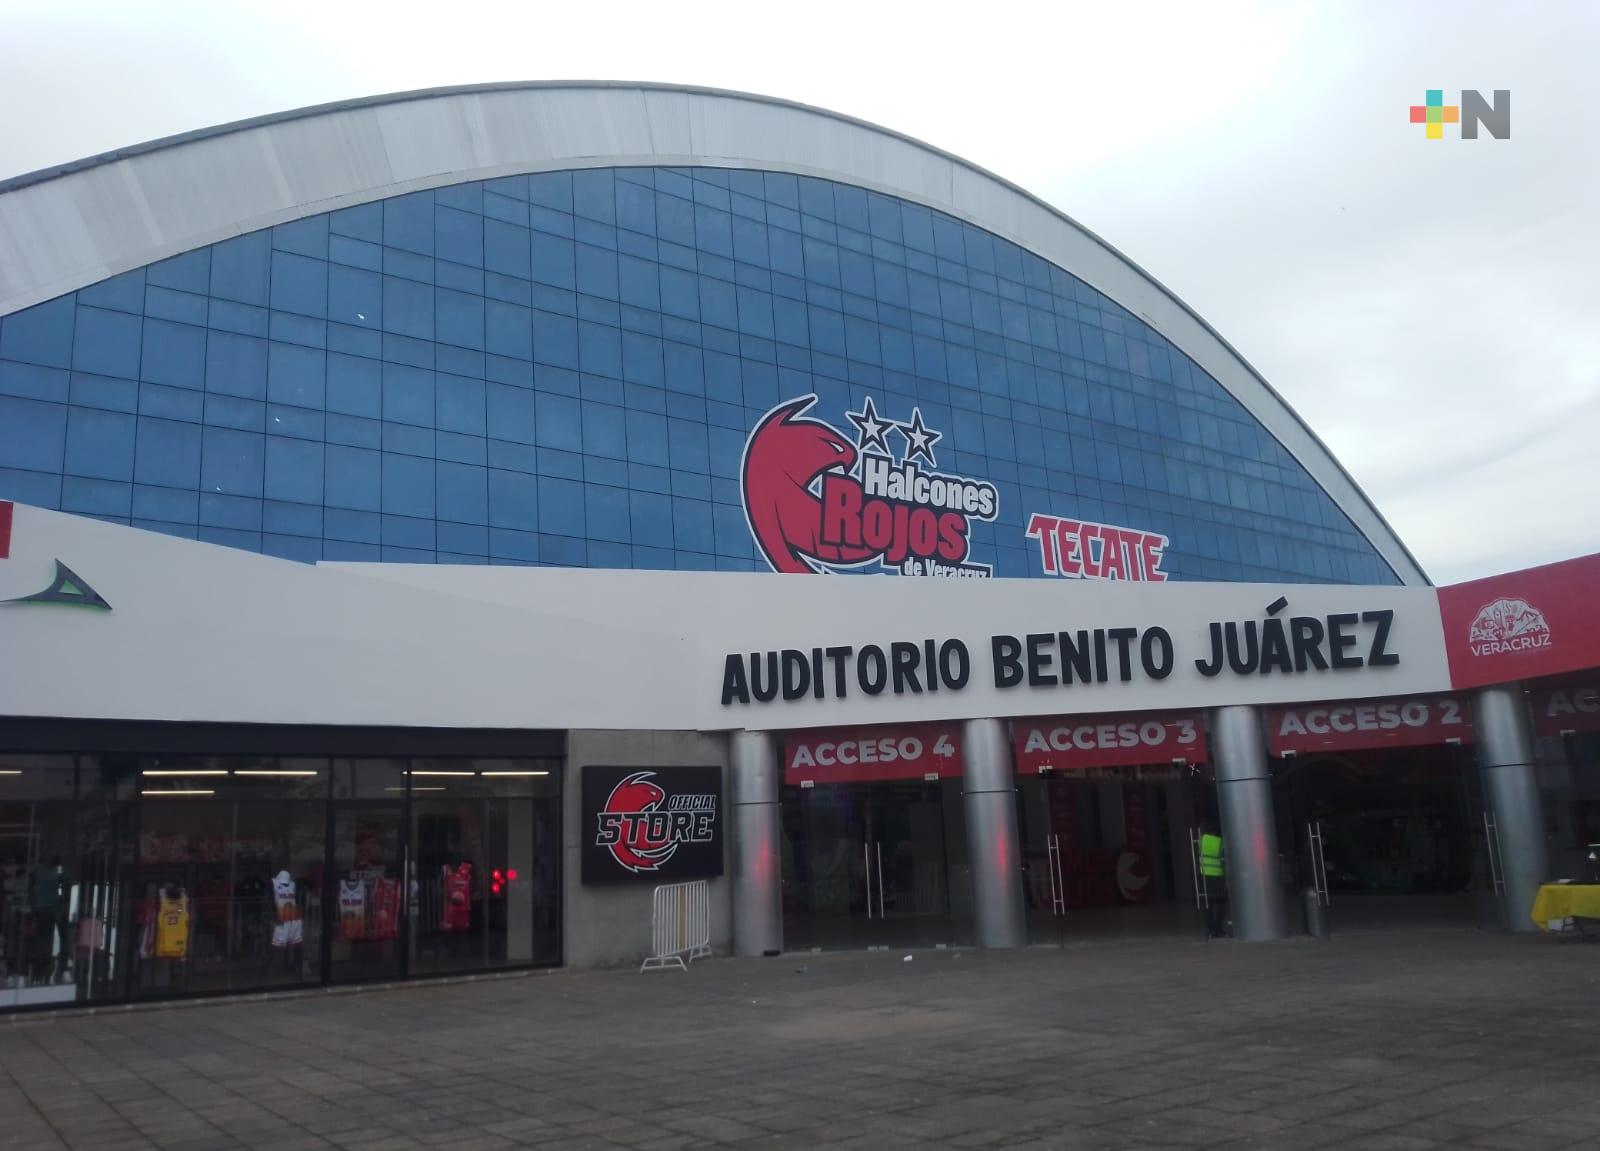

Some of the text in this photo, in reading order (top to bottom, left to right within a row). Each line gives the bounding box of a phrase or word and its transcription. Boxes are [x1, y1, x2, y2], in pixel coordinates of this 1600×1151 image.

[864, 455, 994, 515] Halcones
[1026, 512, 1168, 582] TECATE
[904, 557, 922, 576] de
[721, 596, 1400, 704] AUDITORIO BENITO JUÁREZ
[1471, 634, 1552, 657] VERACRUZ
[1024, 719, 1197, 753] ACCESO 3
[1279, 702, 1461, 736] ACCESO 2
[792, 734, 955, 768] ACCESO 4
[668, 794, 716, 811] OFFICIAL
[596, 810, 716, 845] STORE
